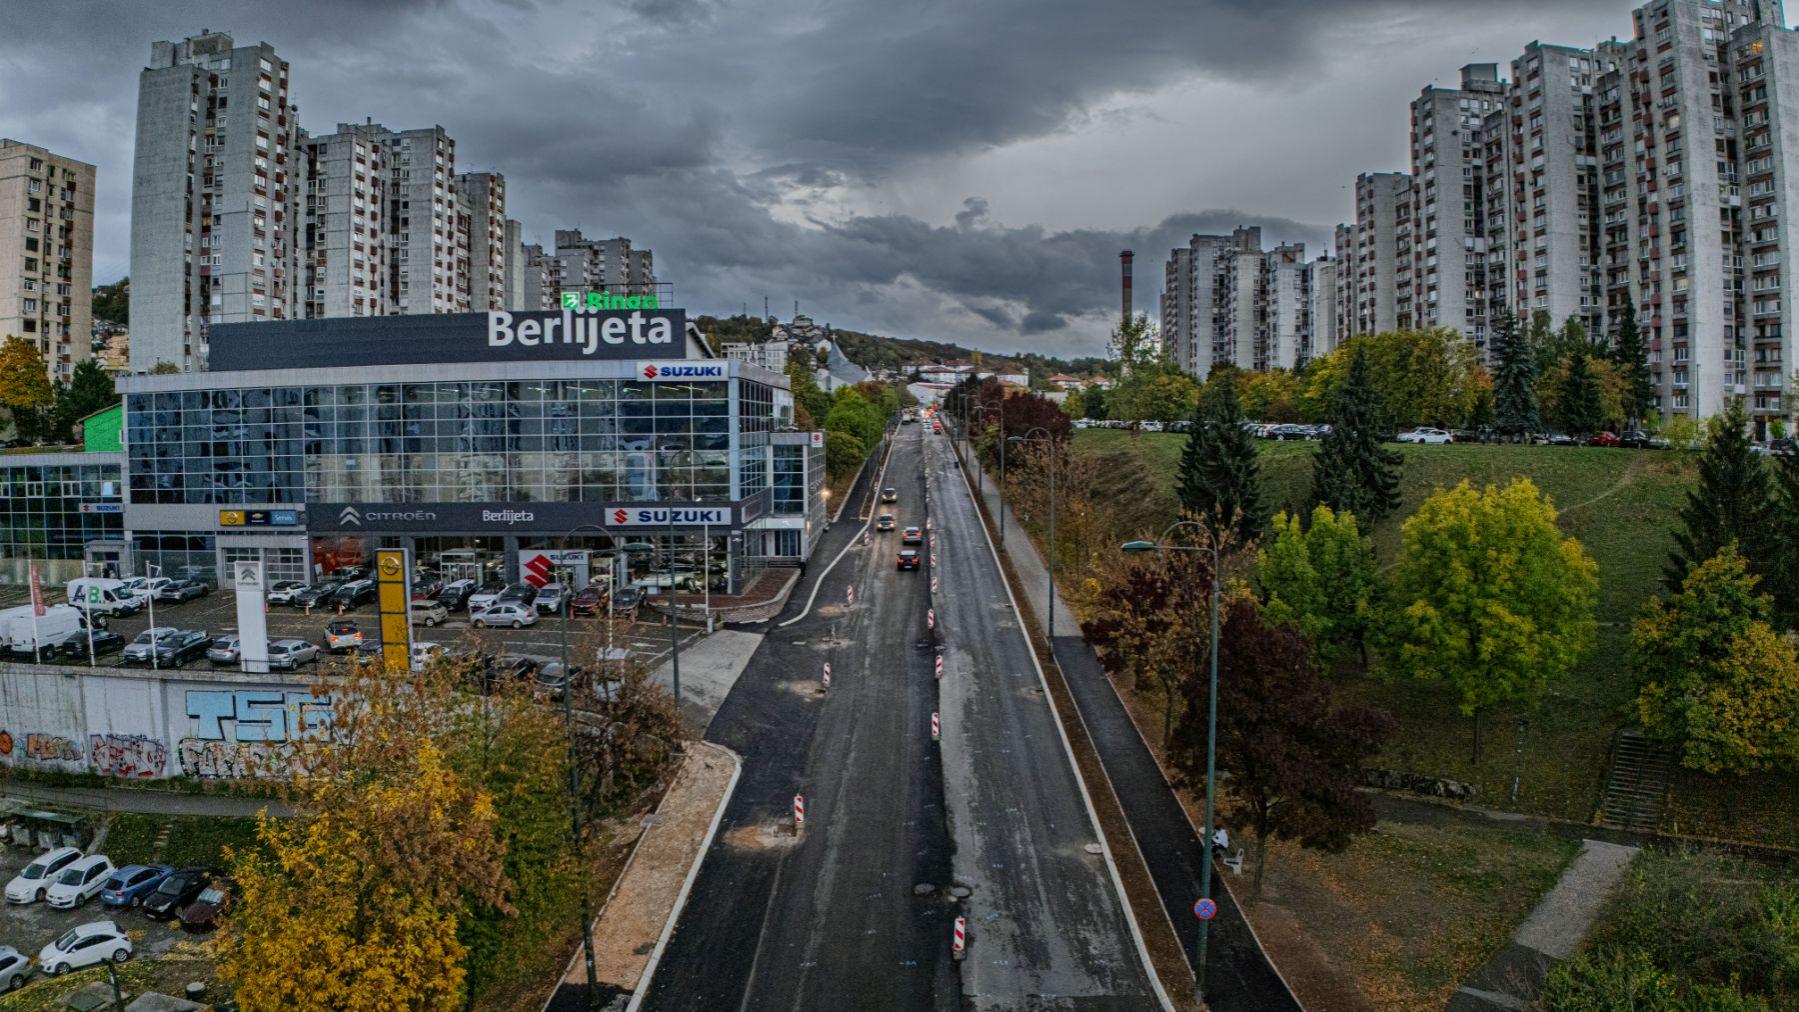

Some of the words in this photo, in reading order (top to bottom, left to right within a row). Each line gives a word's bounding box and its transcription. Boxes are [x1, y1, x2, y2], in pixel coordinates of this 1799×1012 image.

[586, 291, 660, 310] Bingo
[488, 306, 672, 355] Berlijeta
[660, 366, 722, 377] SUZUKI
[365, 510, 437, 521] CITROËN
[482, 510, 534, 525] Berlijeta
[638, 510, 721, 522] SUZUKI
